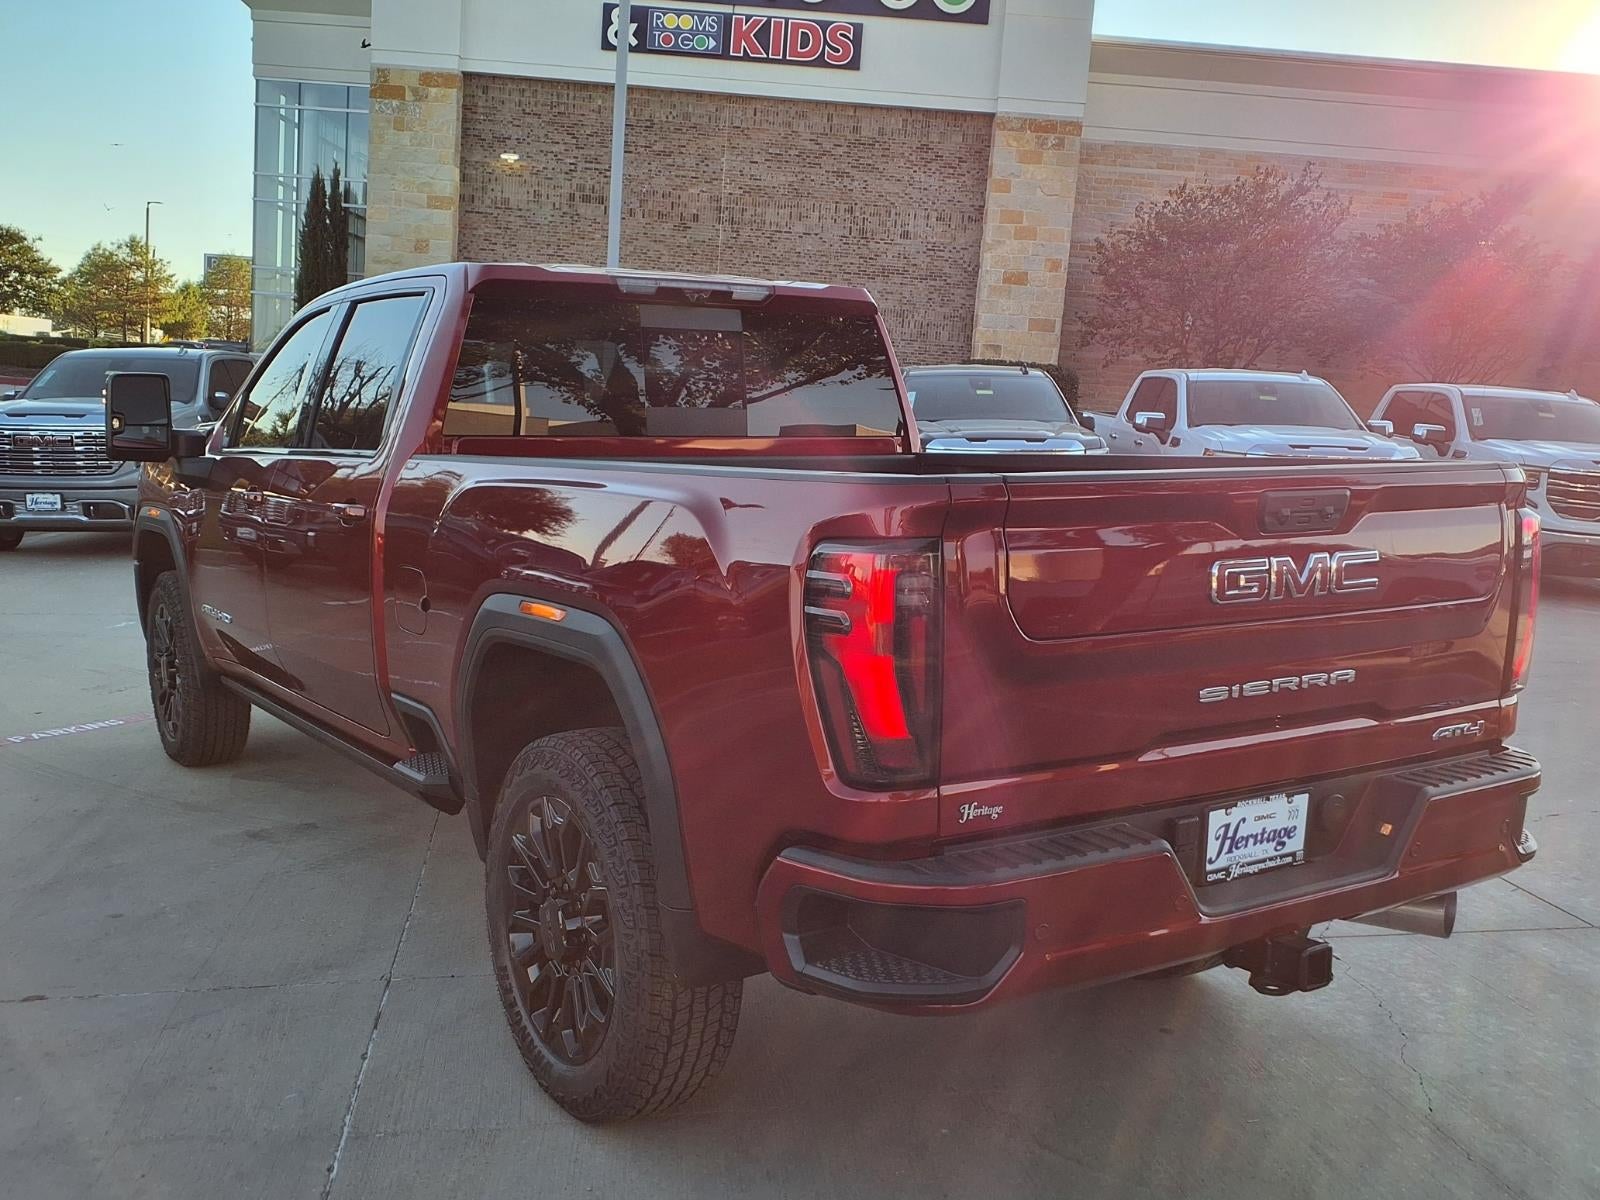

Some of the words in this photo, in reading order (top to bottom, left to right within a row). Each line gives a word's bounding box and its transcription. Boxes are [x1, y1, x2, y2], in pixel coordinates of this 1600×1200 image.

[652, 11, 719, 33] ROOMS
[652, 31, 675, 48] TO
[678, 33, 707, 50] GO
[729, 15, 855, 65] KIDS
[13, 435, 72, 447] GMC
[1210, 549, 1380, 604] GMC
[1198, 669, 1357, 704] SIERRA
[6, 718, 125, 743] PARKING
[1431, 719, 1485, 741] AT4
[958, 801, 1004, 824] Heritage
[1253, 813, 1277, 822] GMC
[1208, 817, 1297, 865] Heritage
[1207, 872, 1226, 882] GMC
